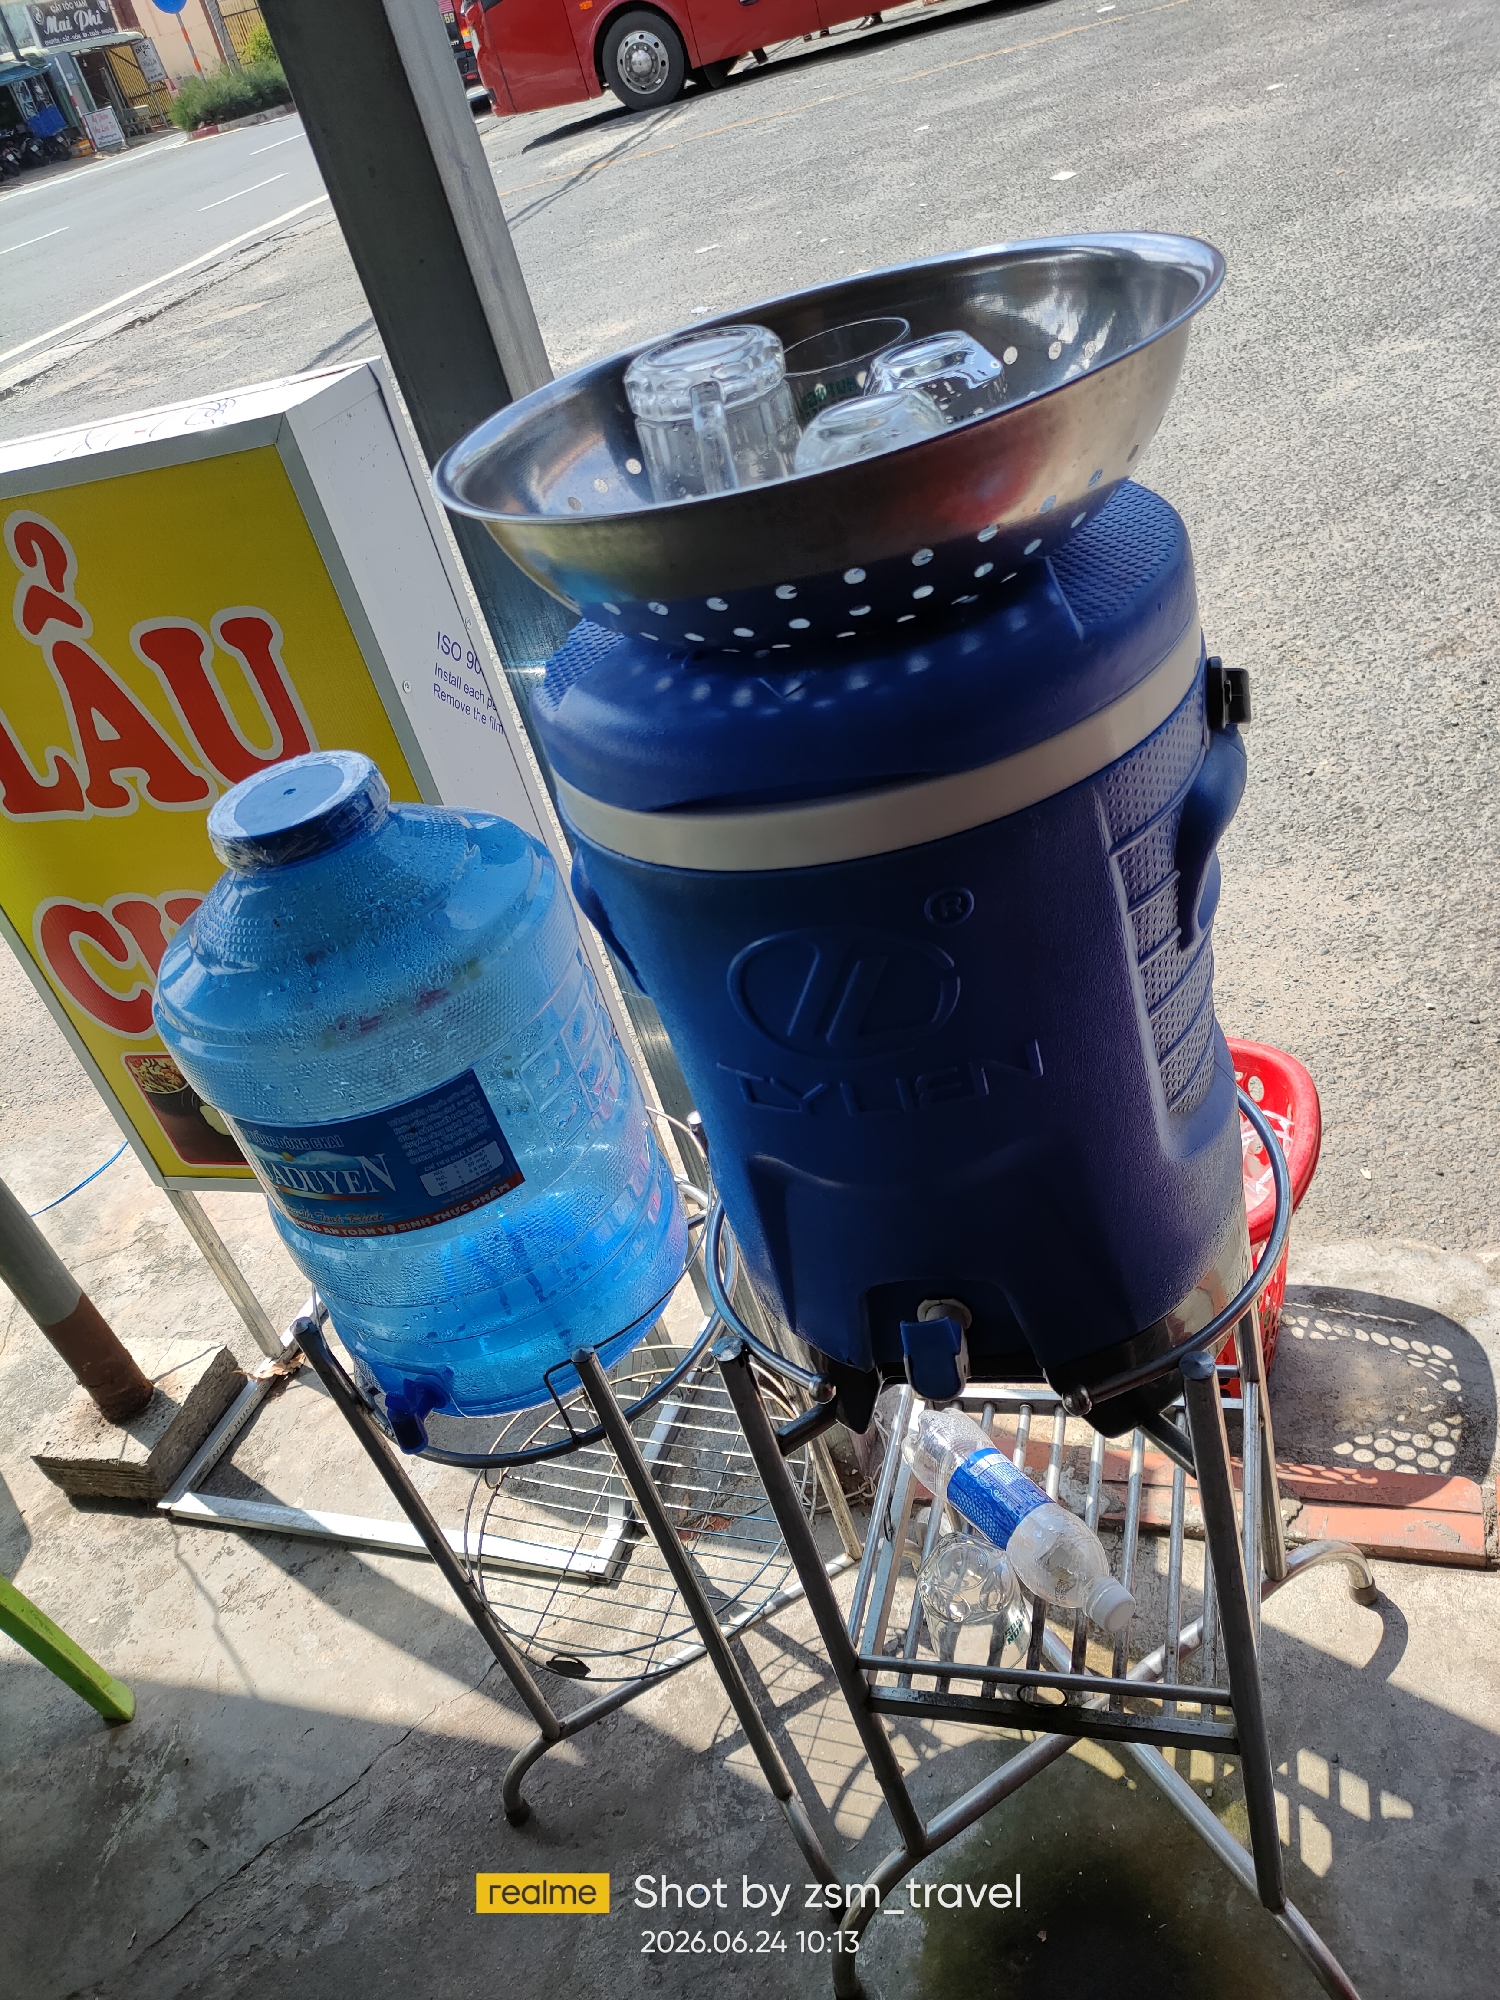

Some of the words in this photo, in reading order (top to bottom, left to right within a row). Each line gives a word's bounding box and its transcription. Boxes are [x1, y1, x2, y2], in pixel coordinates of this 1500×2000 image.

[43, 15, 73, 35] Mai
[73, 9, 103, 31] Phi
[437, 631, 462, 661] ISO
[0, 510, 319, 821] LẨU
[434, 662, 461, 690] Install
[463, 683, 485, 704] each
[433, 683, 471, 715] Remove
[473, 707, 486, 725] the
[489, 715, 504, 735] film
[311, 1134, 345, 1151] CHAI
[323, 1226, 340, 1235] AN
[341, 1225, 377, 1236] TOÀN
[377, 1223, 396, 1234] VỆ
[397, 1216, 433, 1233] SINH
